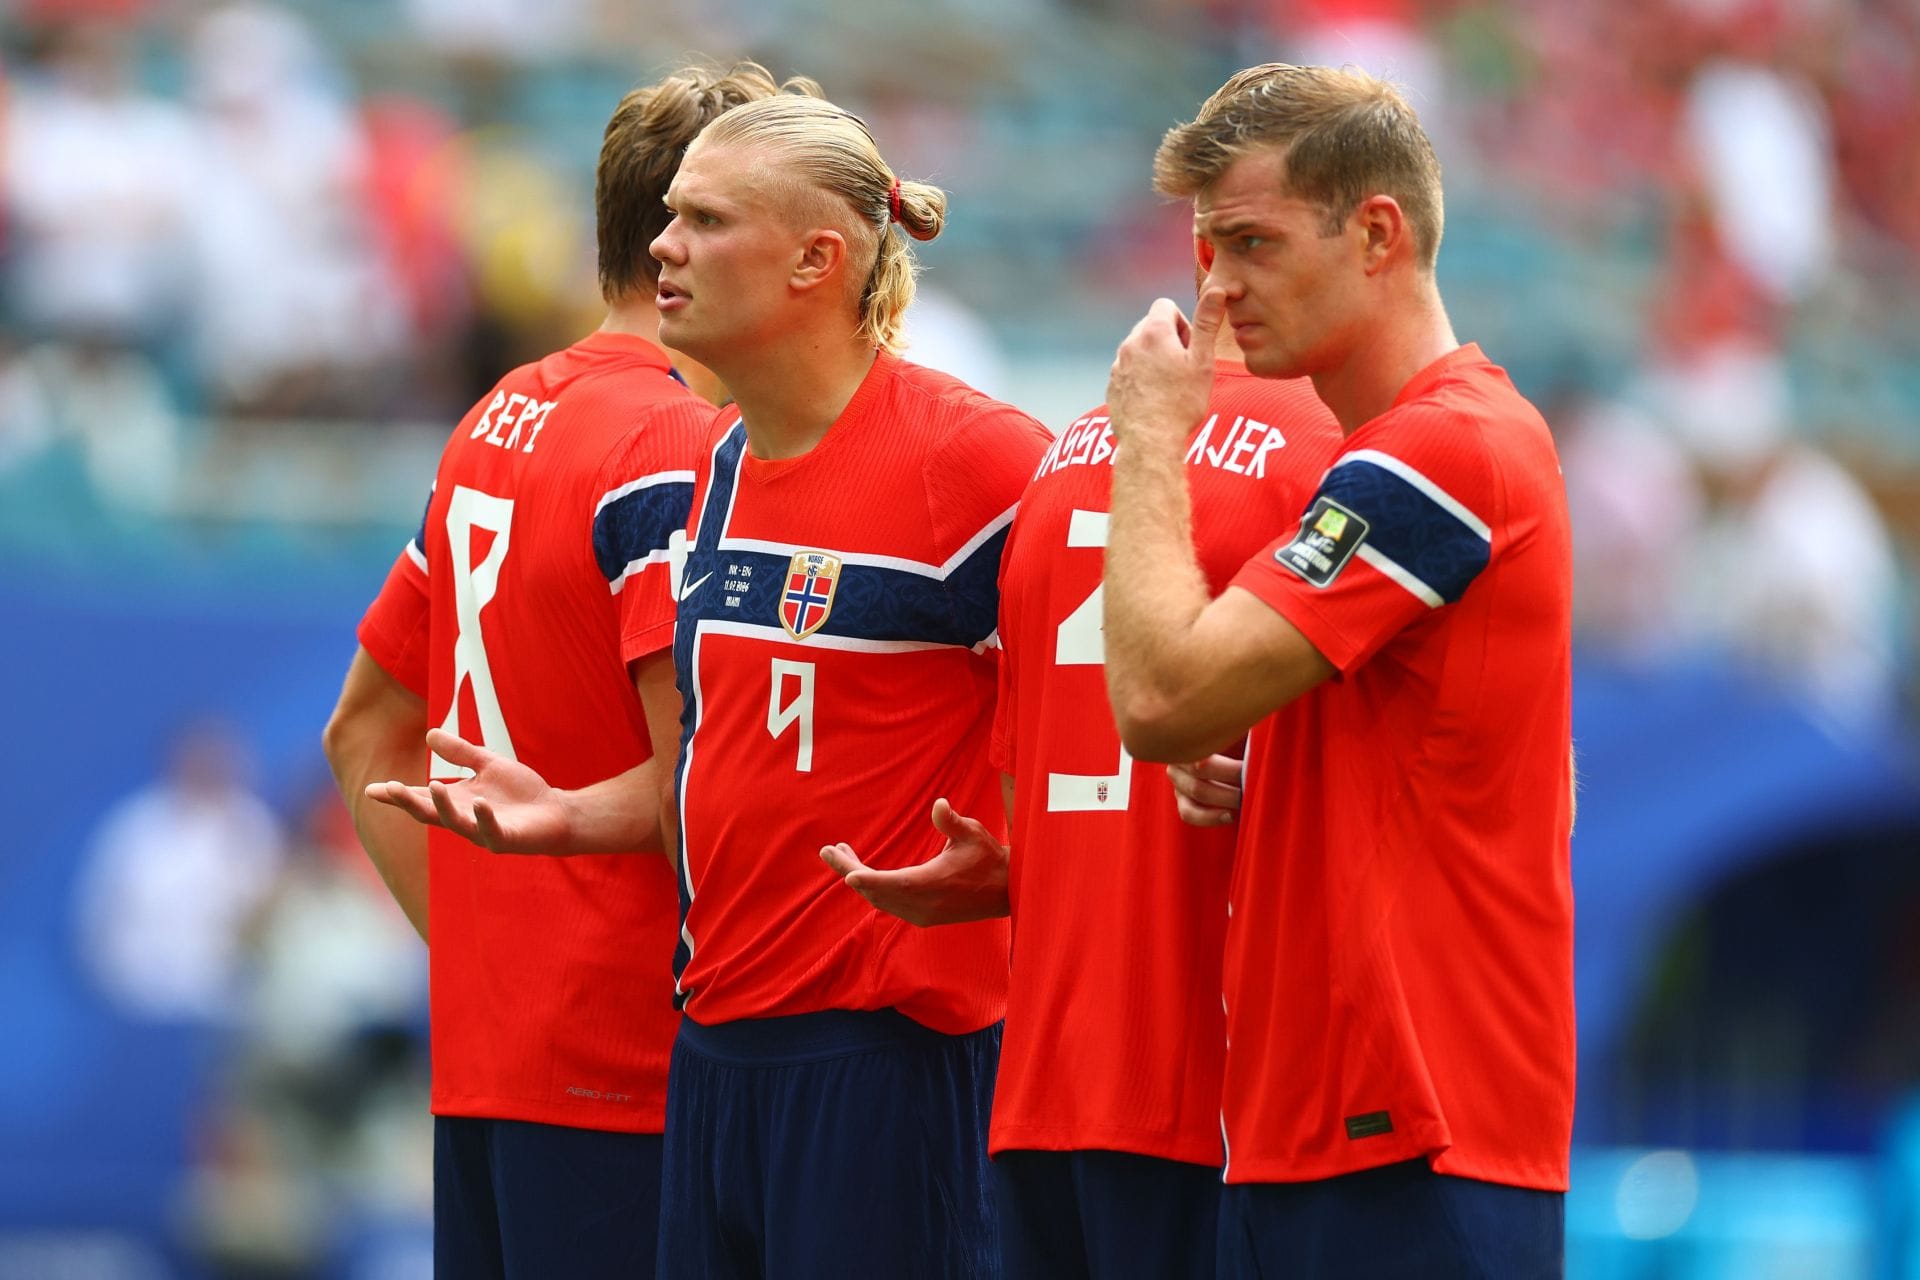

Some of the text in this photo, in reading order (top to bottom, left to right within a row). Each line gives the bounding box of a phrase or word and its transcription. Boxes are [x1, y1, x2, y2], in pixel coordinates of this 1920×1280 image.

[1184, 413, 1287, 479] AJER
[807, 554, 824, 564] NORGE
[430, 485, 518, 780] 8
[767, 657, 815, 773] 9
